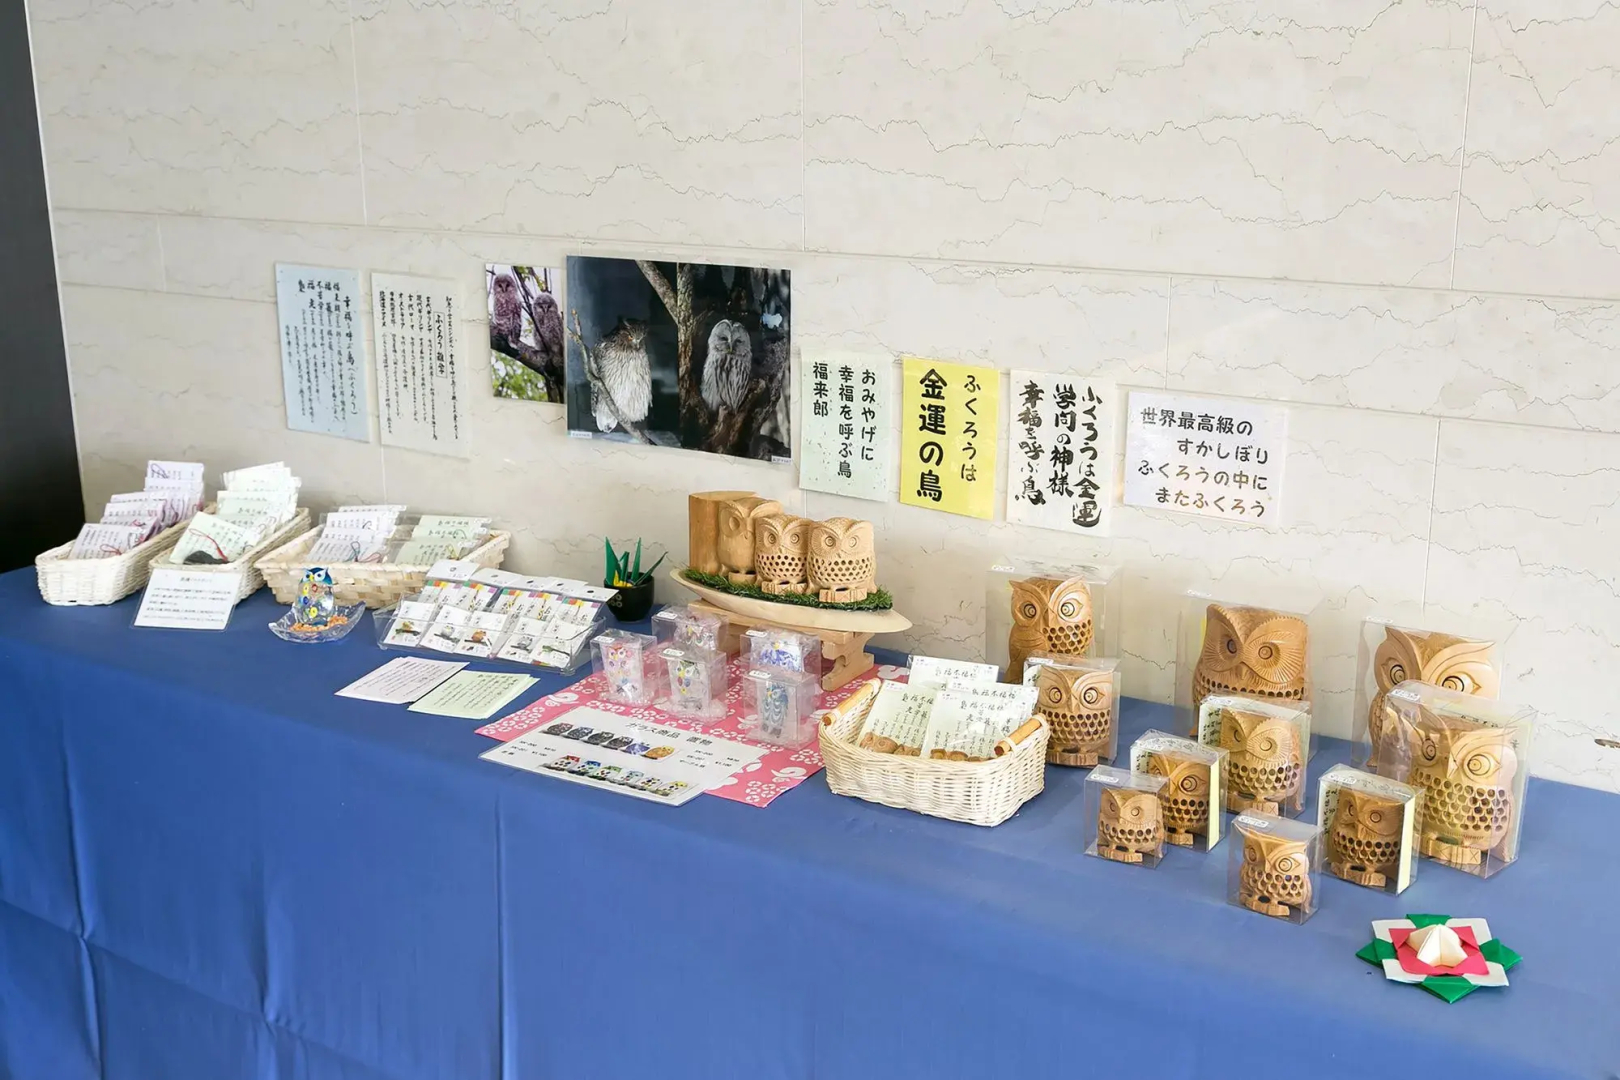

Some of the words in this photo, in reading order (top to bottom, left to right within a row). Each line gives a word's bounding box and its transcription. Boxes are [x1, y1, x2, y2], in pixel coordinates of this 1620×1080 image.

[812, 362, 829, 418] 福来郎
[837, 365, 855, 479] 幸福を呼ぶ鳥
[861, 369, 877, 461] おみやげに
[916, 368, 948, 503] 金運の鳥
[960, 374, 982, 482] ふくろうは
[1140, 406, 1254, 436] 世界最高級の
[1014, 379, 1047, 506] 幸福を呼ぶ鳥
[1046, 383, 1077, 498] 学問の神様
[1072, 385, 1104, 528] ふくろうは金運
[1137, 459, 1268, 492] ふくろうの中に
[1176, 438, 1269, 465] すかしぼり
[1155, 486, 1266, 518] またふくろう
[625, 722, 681, 739] ガラス商品
